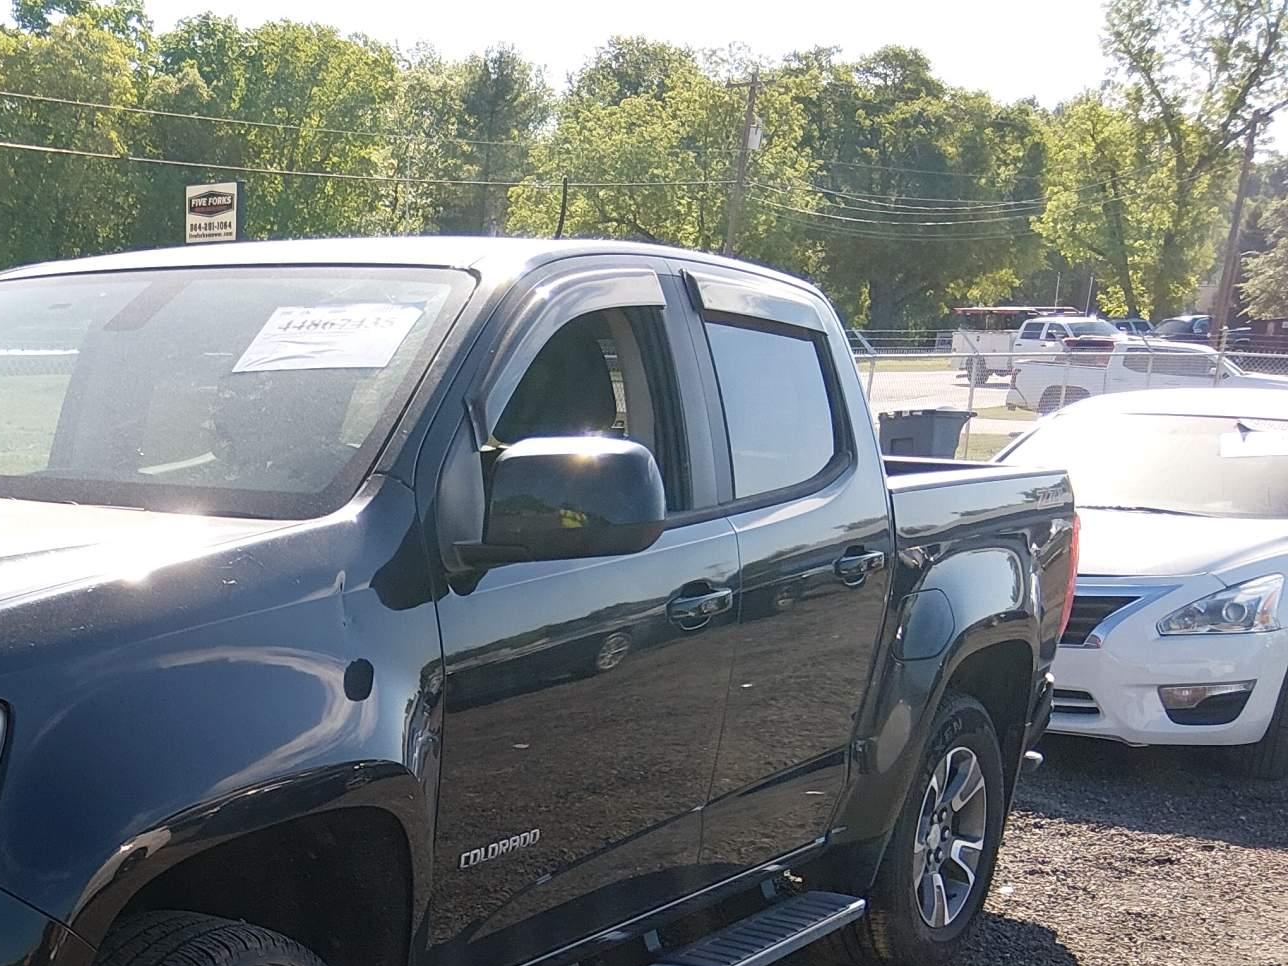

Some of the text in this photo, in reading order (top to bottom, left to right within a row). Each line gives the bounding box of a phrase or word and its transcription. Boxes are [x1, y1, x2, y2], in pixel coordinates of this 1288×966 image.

[191, 196, 232, 208] FIVE FORKS
[459, 828, 540, 868] COLORADO
